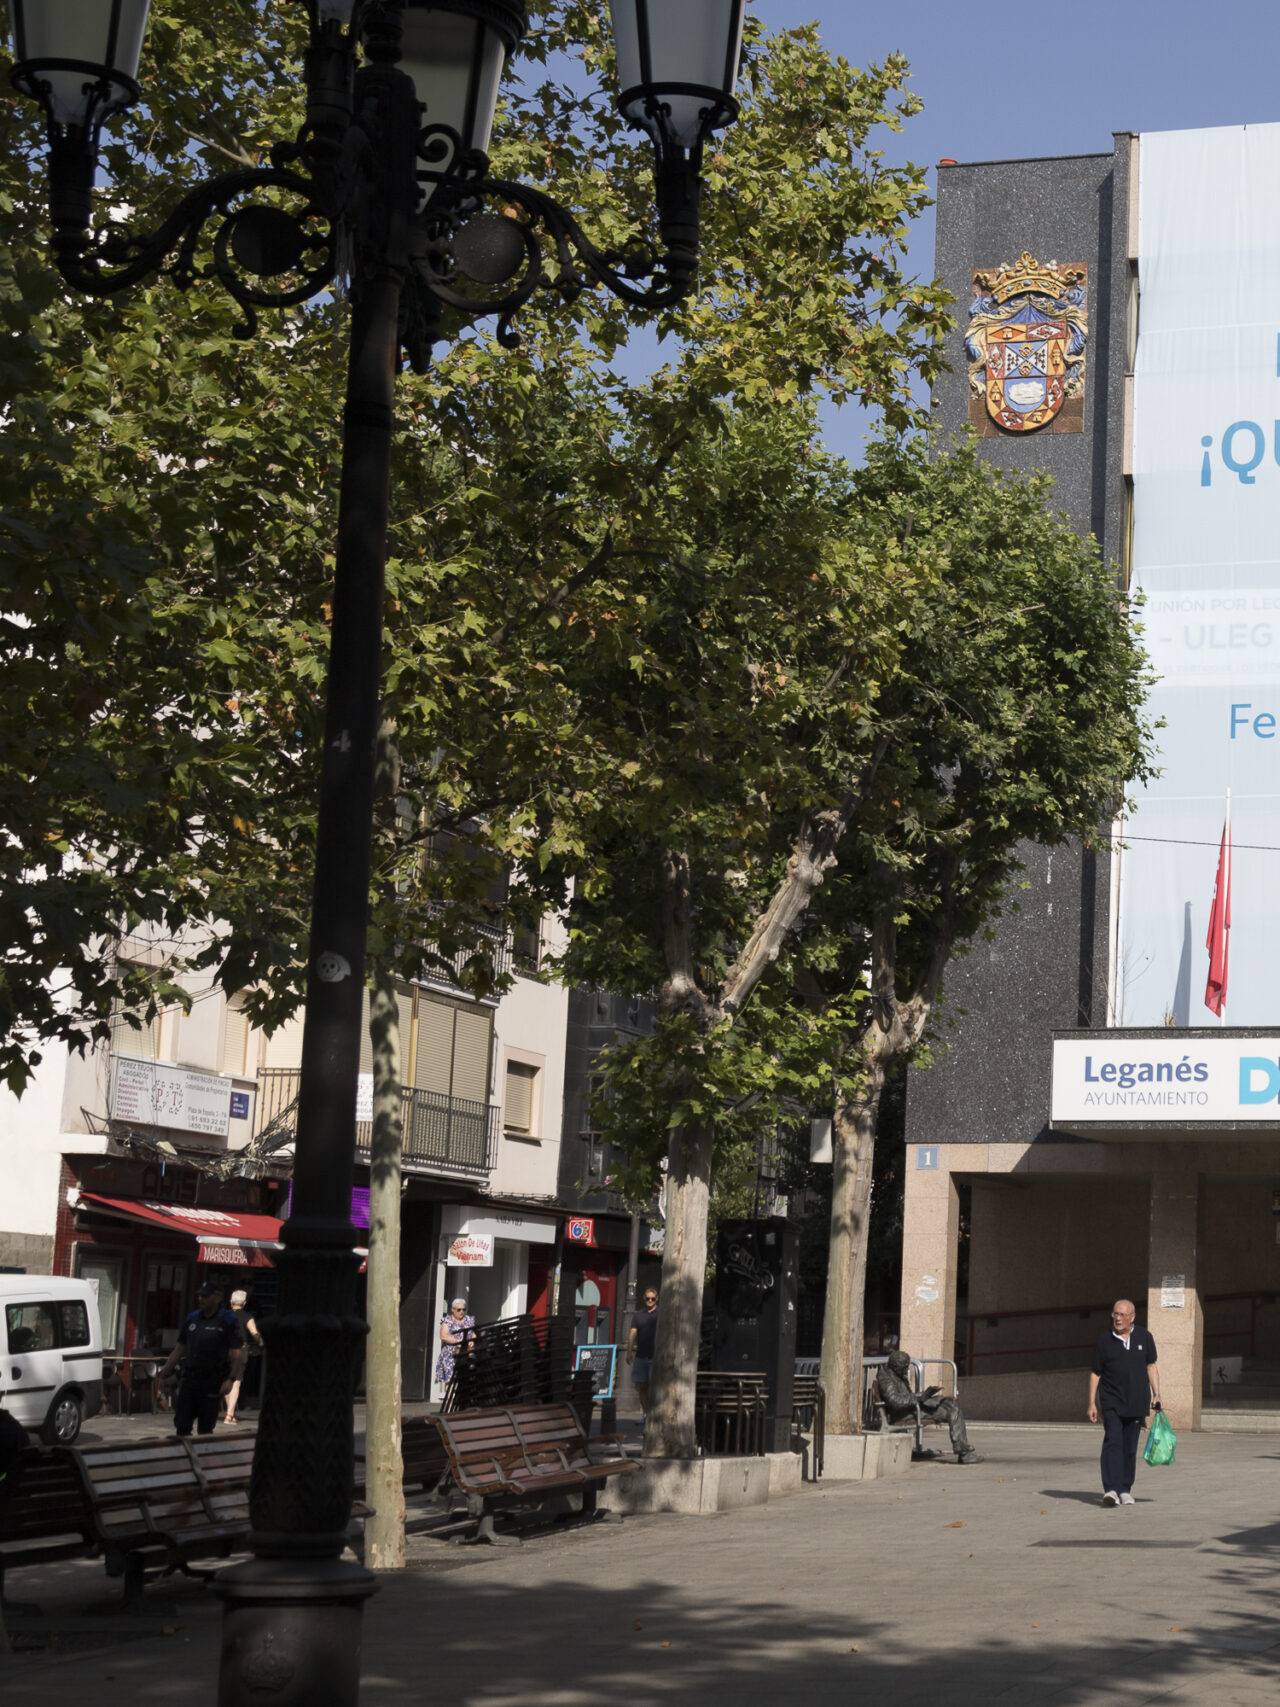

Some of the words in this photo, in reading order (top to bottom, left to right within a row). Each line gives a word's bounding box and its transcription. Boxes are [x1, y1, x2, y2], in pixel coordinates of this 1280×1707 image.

[1085, 1055, 1209, 1089] Leganés
[1084, 1091, 1209, 1106] AYUNTAMIENTO
[924, 1151, 932, 1166] 1
